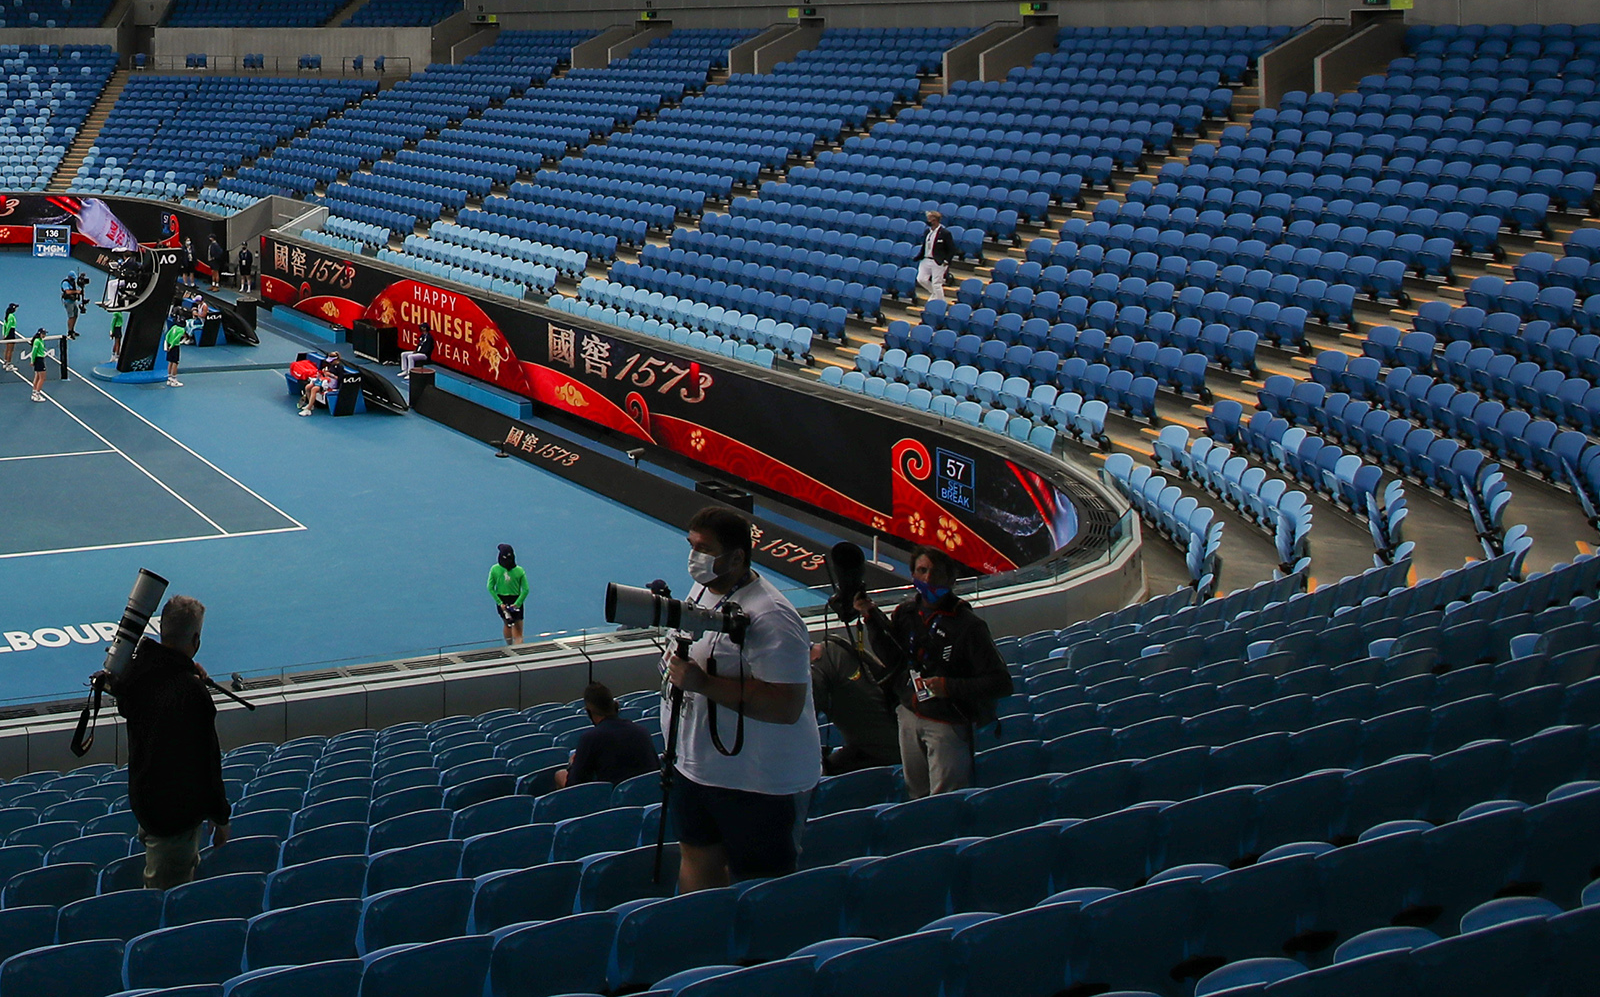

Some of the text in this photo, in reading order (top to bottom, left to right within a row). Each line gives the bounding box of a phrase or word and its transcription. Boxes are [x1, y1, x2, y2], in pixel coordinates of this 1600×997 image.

[45, 229, 59, 238] 136
[414, 285, 457, 312] HAPPY
[401, 300, 473, 344] CHINESE
[402, 328, 470, 366] NE YEAR
[946, 458, 965, 480] 57
[941, 487, 970, 509] BREAK
[948, 480, 963, 496] SET
